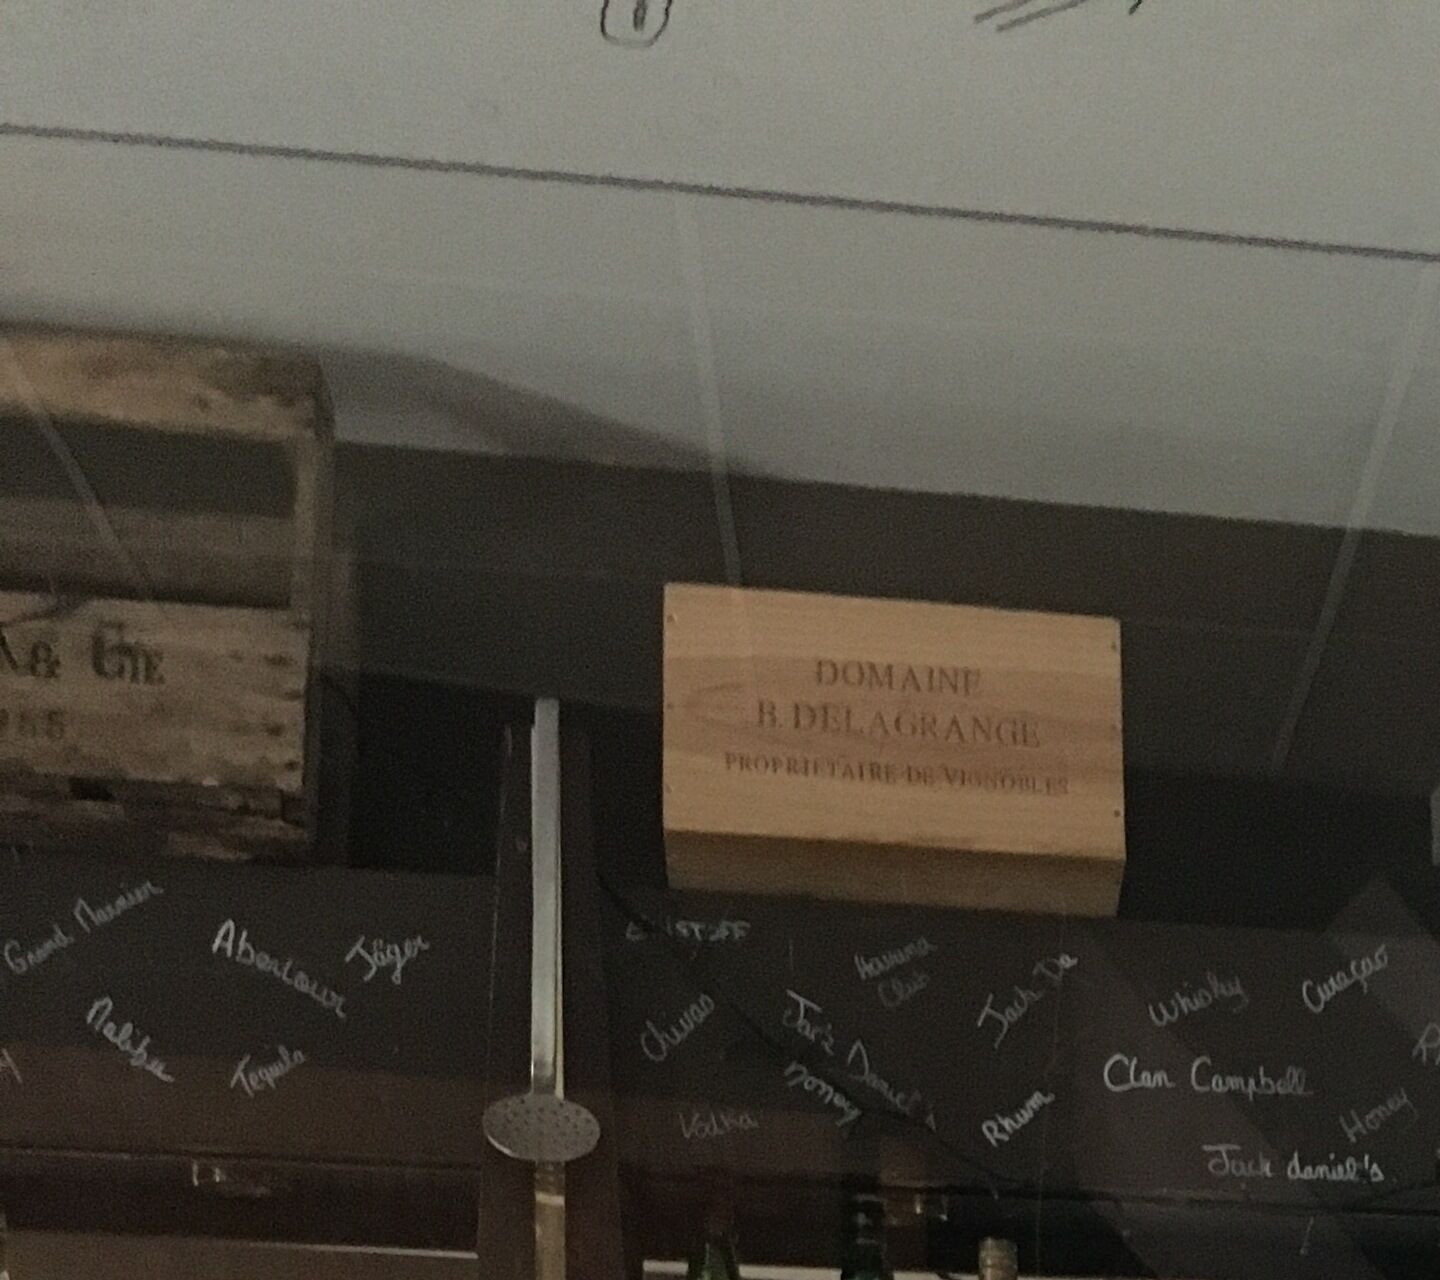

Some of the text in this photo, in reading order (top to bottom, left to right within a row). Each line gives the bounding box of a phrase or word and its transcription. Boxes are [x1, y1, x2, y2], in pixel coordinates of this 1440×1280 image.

[813, 658, 983, 697] DOMAINE
[792, 702, 1041, 749] DELAGRANGE
[906, 765, 936, 785] DE
[1102, 1052, 1314, 1103] Clan Campbell
[979, 1088, 1056, 1149] Rhum
